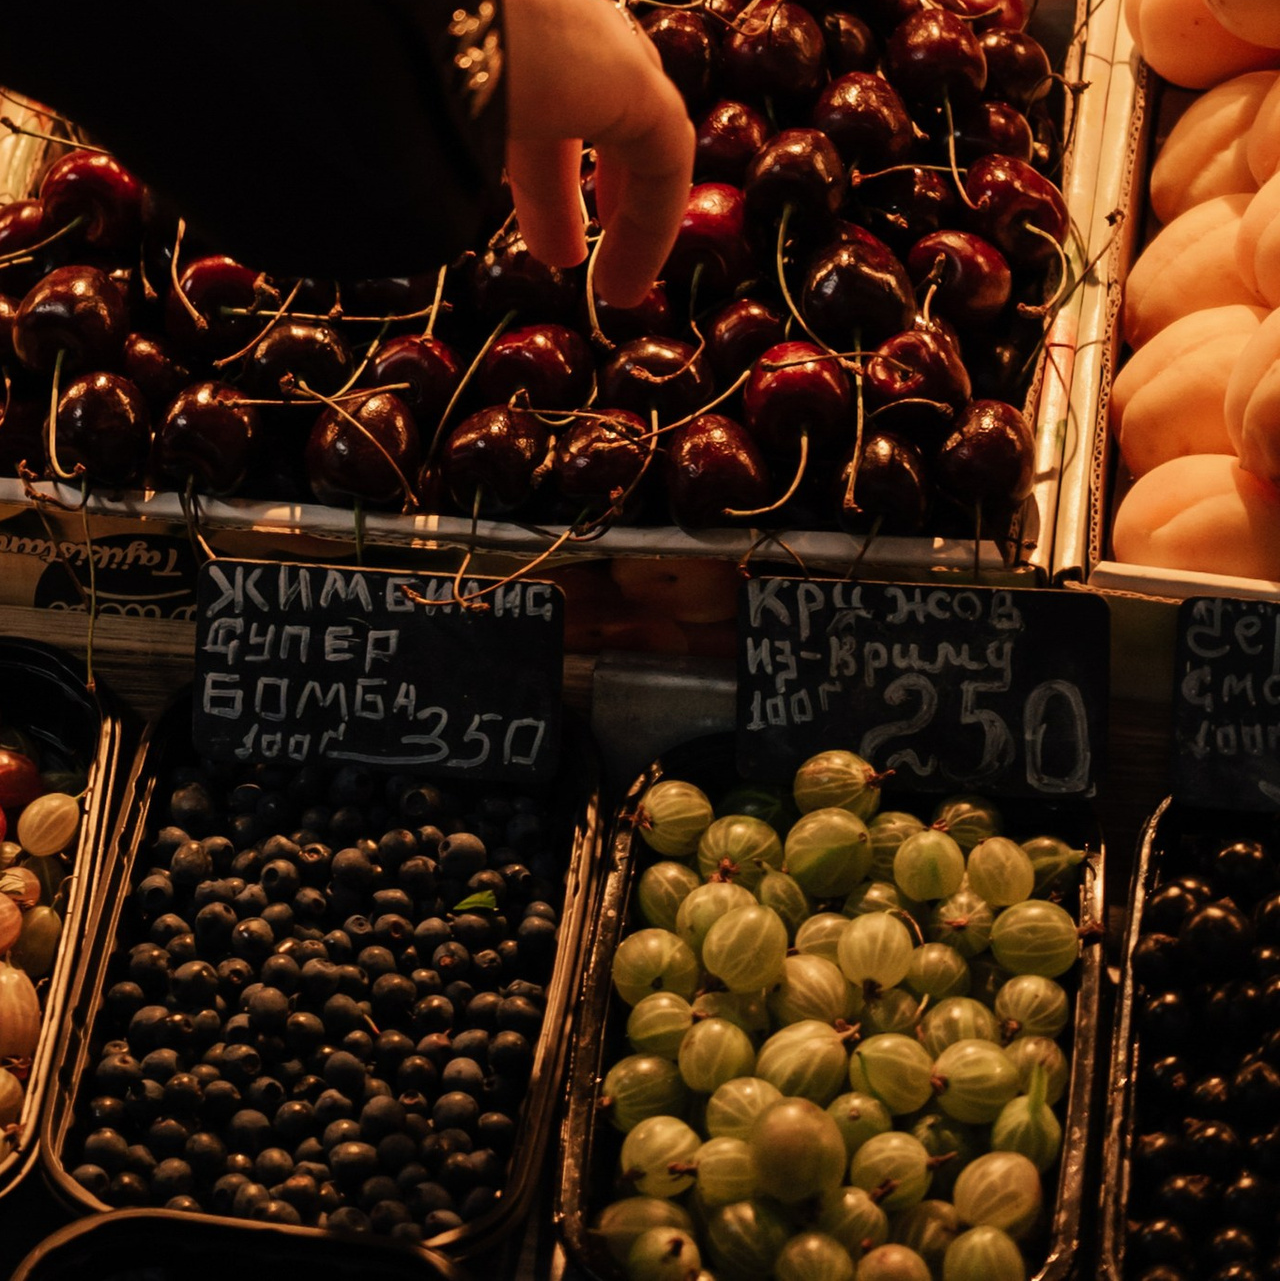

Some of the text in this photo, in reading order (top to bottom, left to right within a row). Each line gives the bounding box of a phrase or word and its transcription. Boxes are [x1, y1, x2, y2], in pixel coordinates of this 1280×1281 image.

[203, 671, 418, 721] БОМБА
[327, 706, 546, 768] 350
[859, 672, 1096, 797] 250
